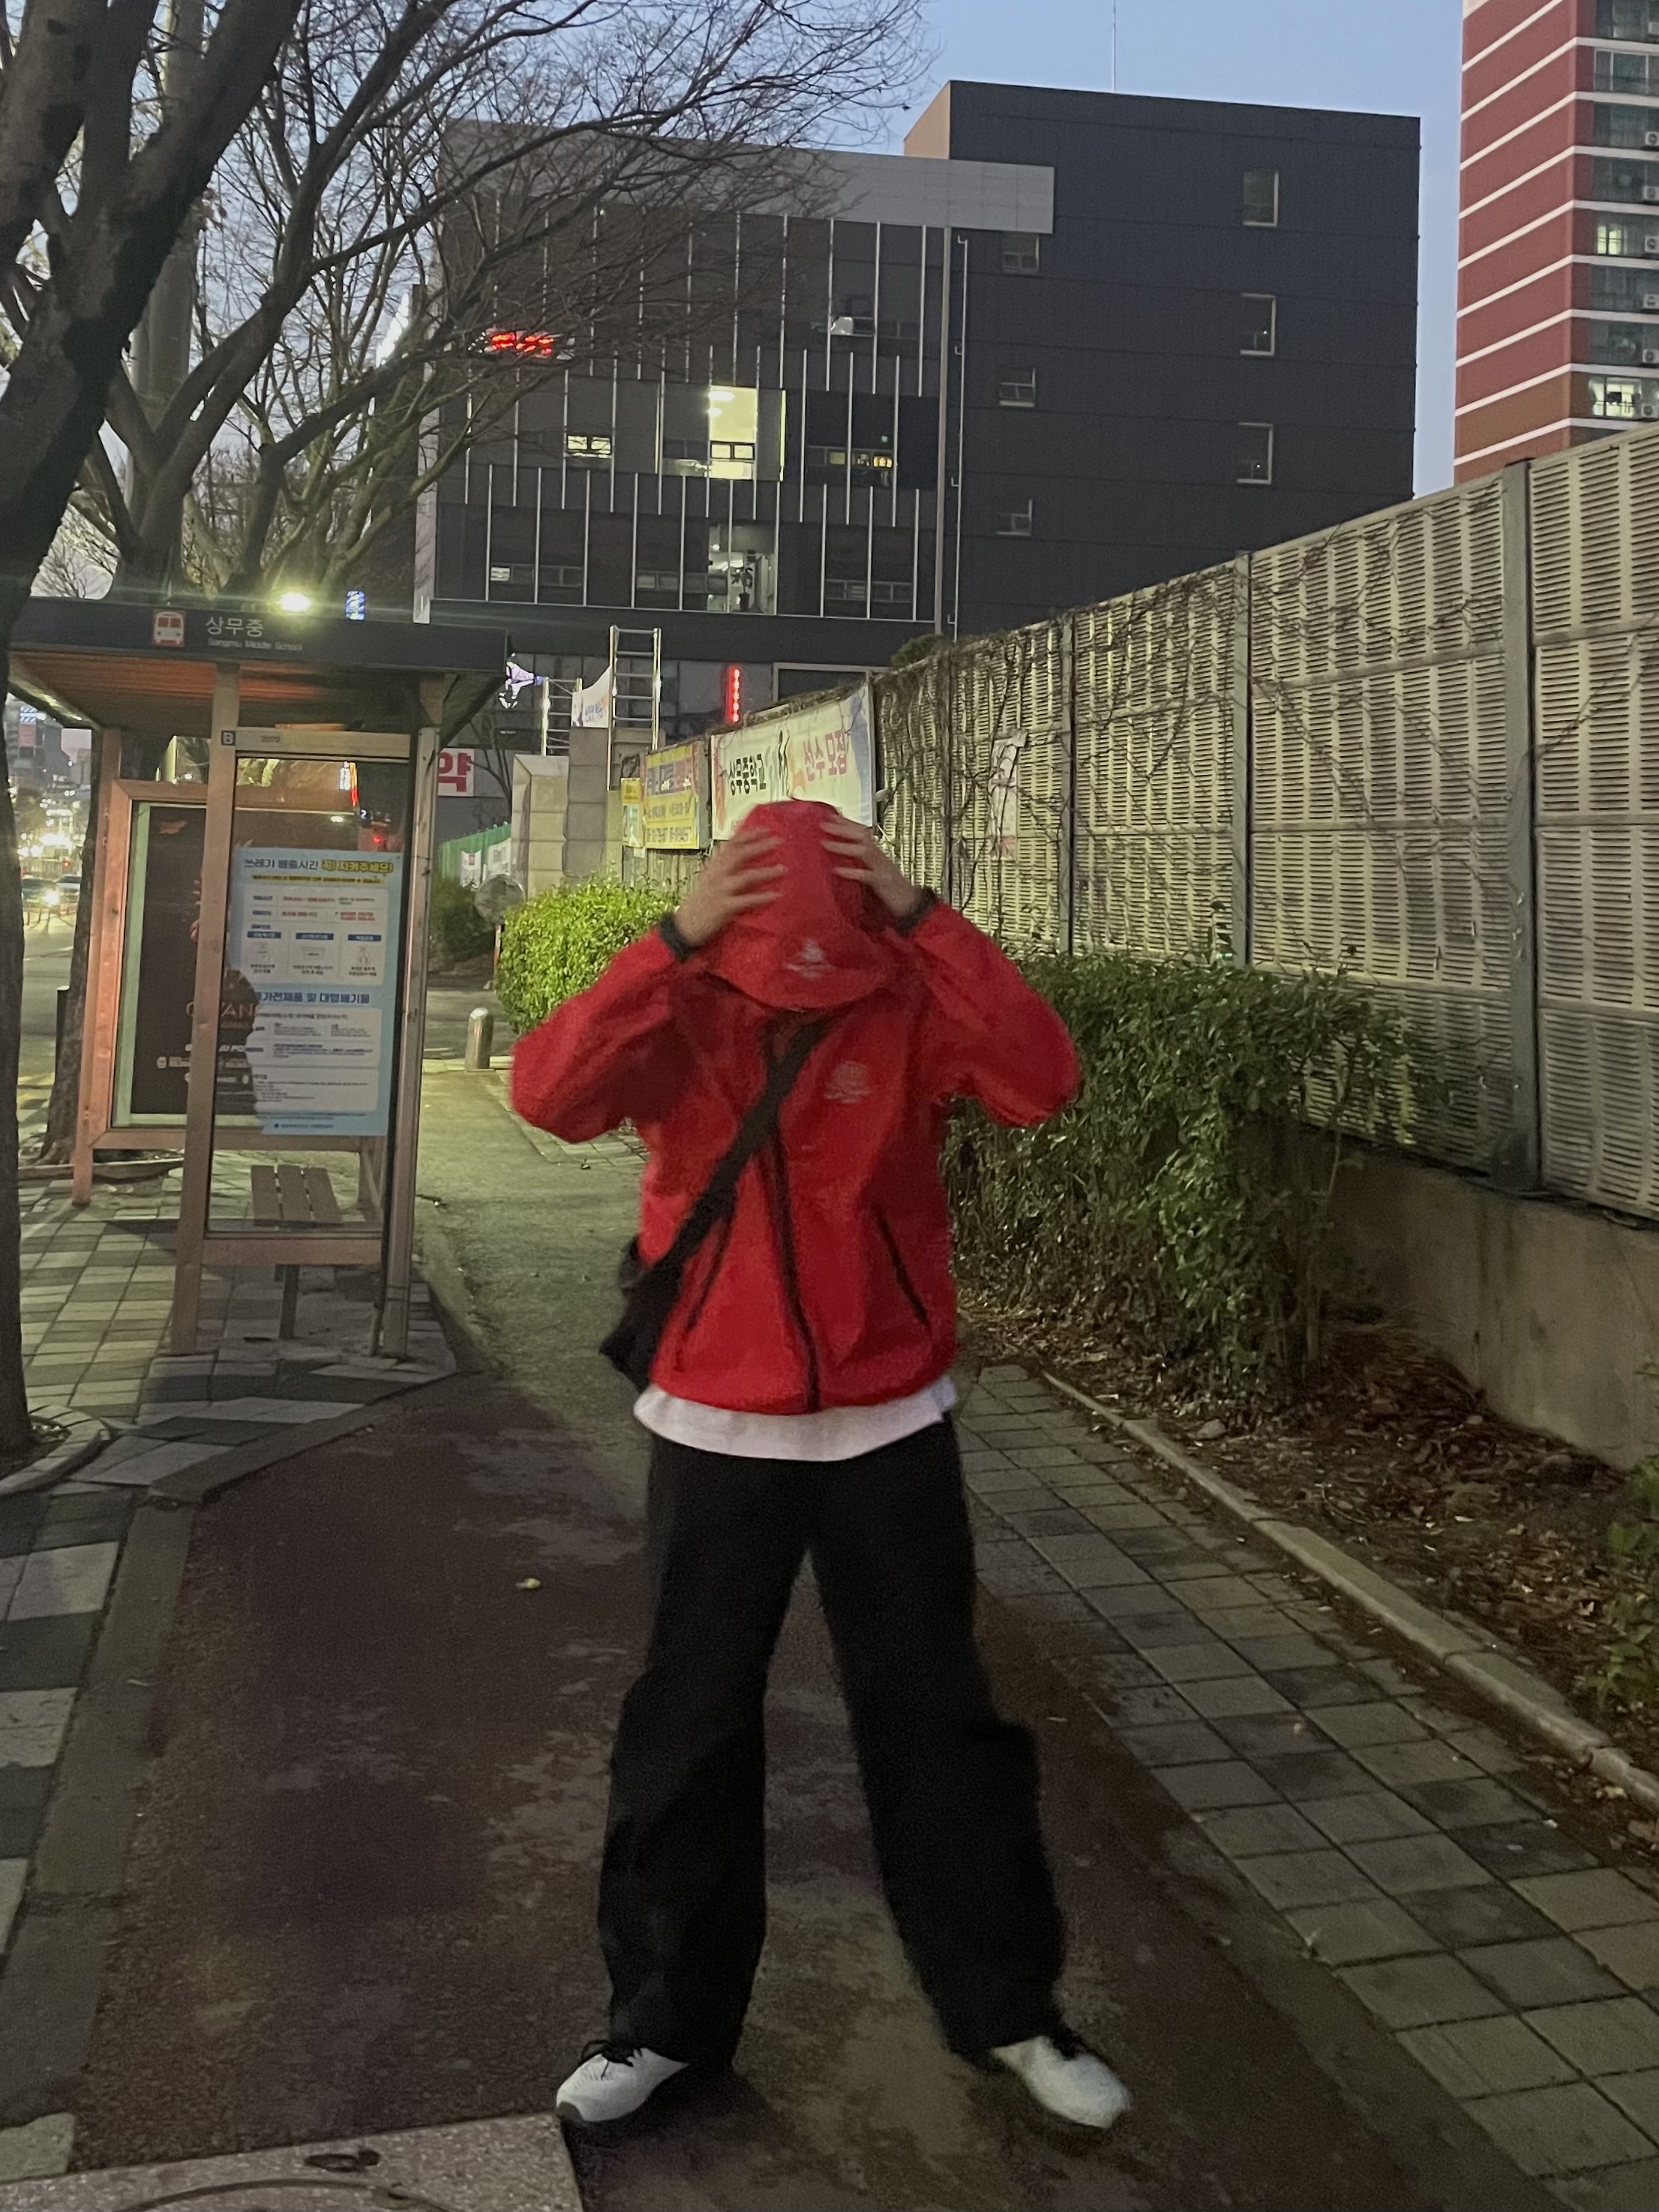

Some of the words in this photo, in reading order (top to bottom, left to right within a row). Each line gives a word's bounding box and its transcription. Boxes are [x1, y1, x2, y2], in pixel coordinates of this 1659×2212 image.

[206, 617, 264, 637] 상무중
[223, 732, 233, 745] B
[728, 753, 767, 797] 상무중학교
[803, 736, 825, 782] 선수
[825, 728, 848, 776] 모집
